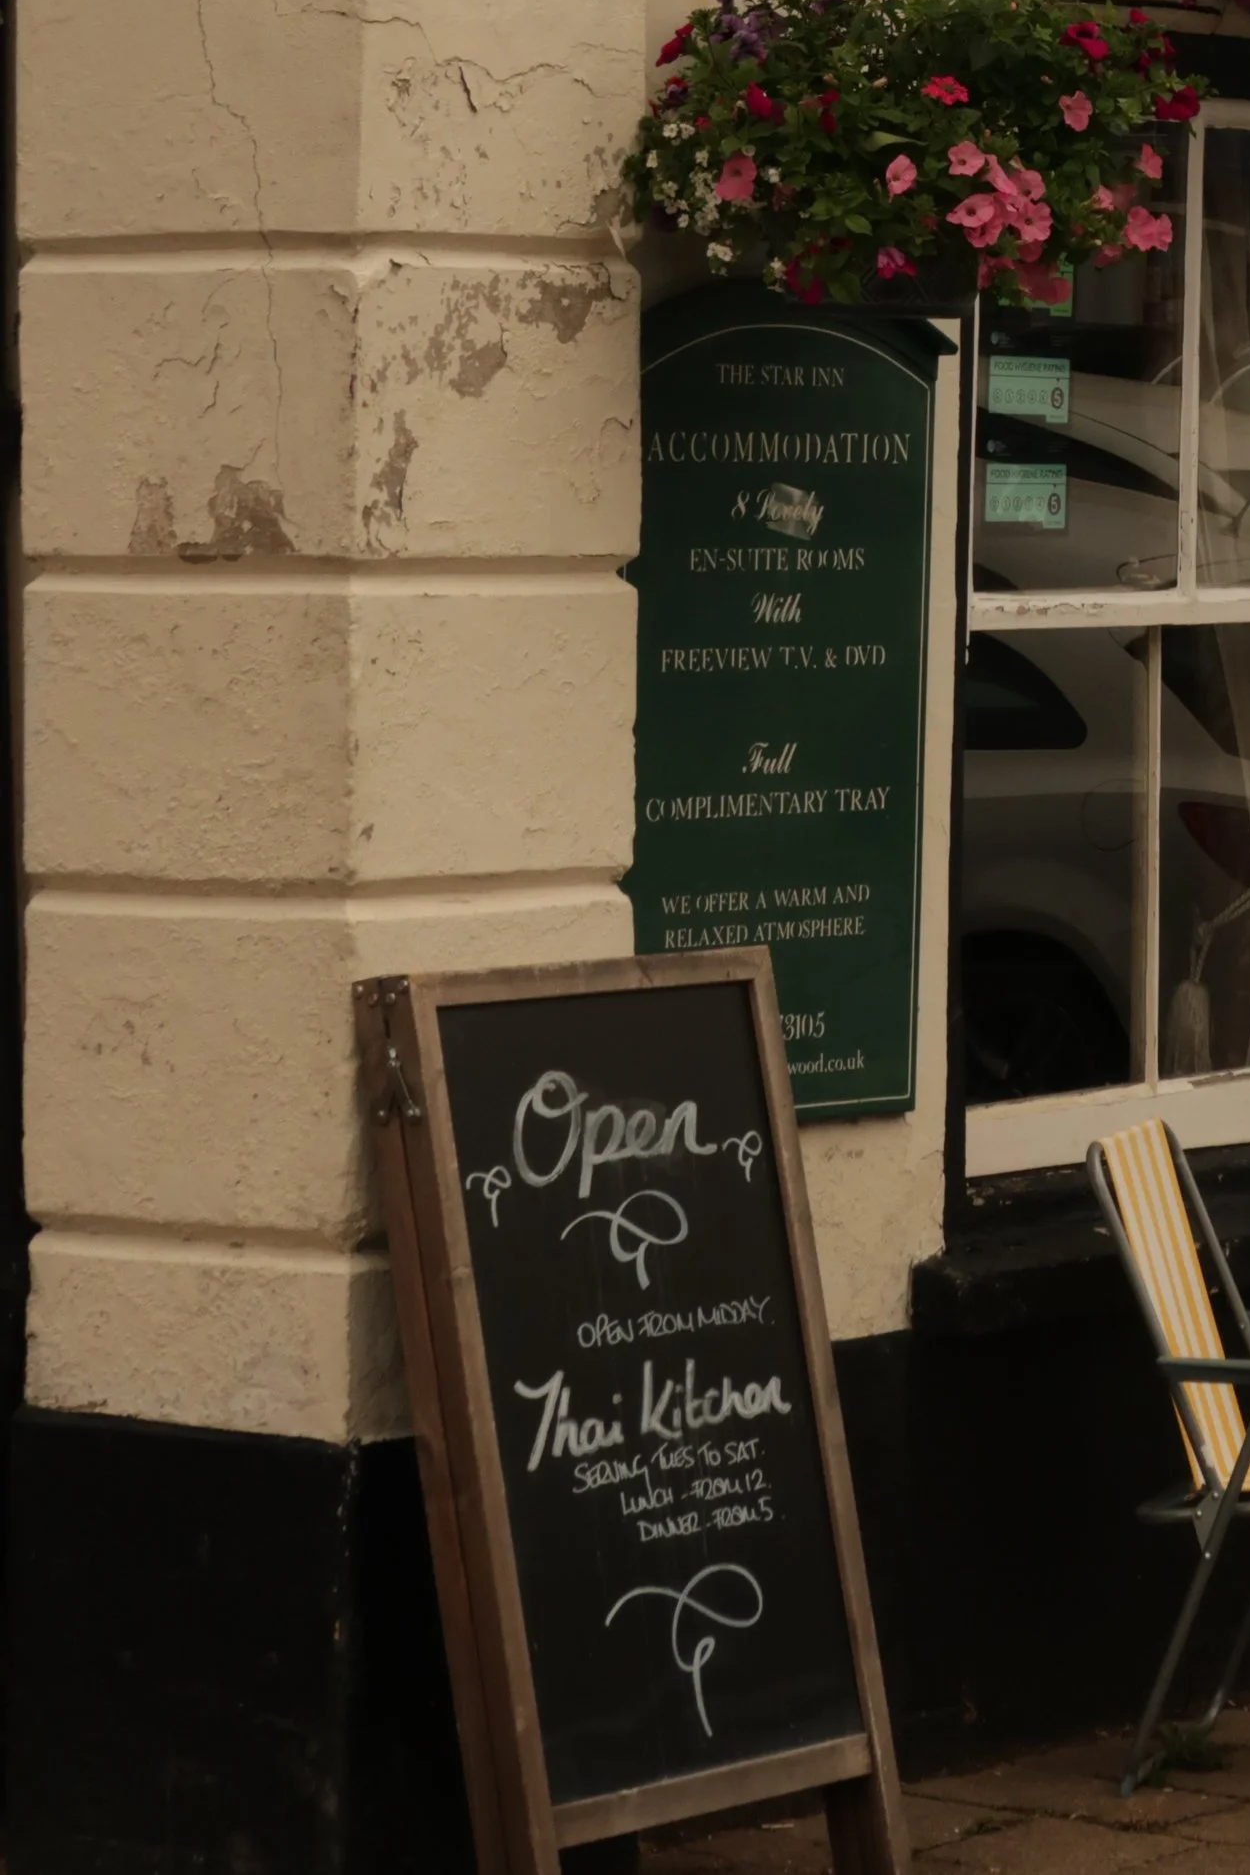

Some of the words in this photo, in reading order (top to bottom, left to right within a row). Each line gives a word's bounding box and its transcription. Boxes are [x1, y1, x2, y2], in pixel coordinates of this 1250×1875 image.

[717, 363, 755, 385] THE
[761, 365, 805, 386] STAR
[811, 367, 845, 388] INN
[647, 432, 911, 465] ACCOMMODATION
[731, 490, 750, 520] 8
[754, 488, 825, 536] Lovely
[690, 547, 789, 573] EN-SUITE
[796, 547, 865, 572] ROOMS
[751, 592, 802, 624] With
[661, 646, 773, 673] FREEVIEW
[779, 645, 817, 670] T.V.
[824, 646, 837, 669] &
[845, 644, 886, 666] DVD
[742, 741, 800, 775] Full
[646, 789, 828, 823] COMPLIMENTARY
[834, 786, 891, 813] TRAY
[661, 895, 691, 915] WE
[696, 891, 750, 913] OFFER
[755, 890, 767, 910] A
[774, 886, 827, 907] WARM
[832, 884, 870, 905] AND
[664, 925, 748, 949] RELAXED
[753, 915, 866, 942] ATMOSPHERE
[513, 1070, 718, 1199] Open
[577, 1313, 634, 1348] OPEN
[638, 1306, 694, 1338] FROM
[513, 1369, 625, 1472] Thai
[640, 1358, 792, 1440] Kitchen
[572, 1454, 652, 1495] SERVING
[651, 1441, 695, 1470] TUES
[697, 1442, 721, 1466] TO
[620, 1487, 674, 1516] LUNCH
[689, 1478, 743, 1501] FROM
[636, 1513, 702, 1542] DINNER
[712, 1505, 761, 1531] FROM
